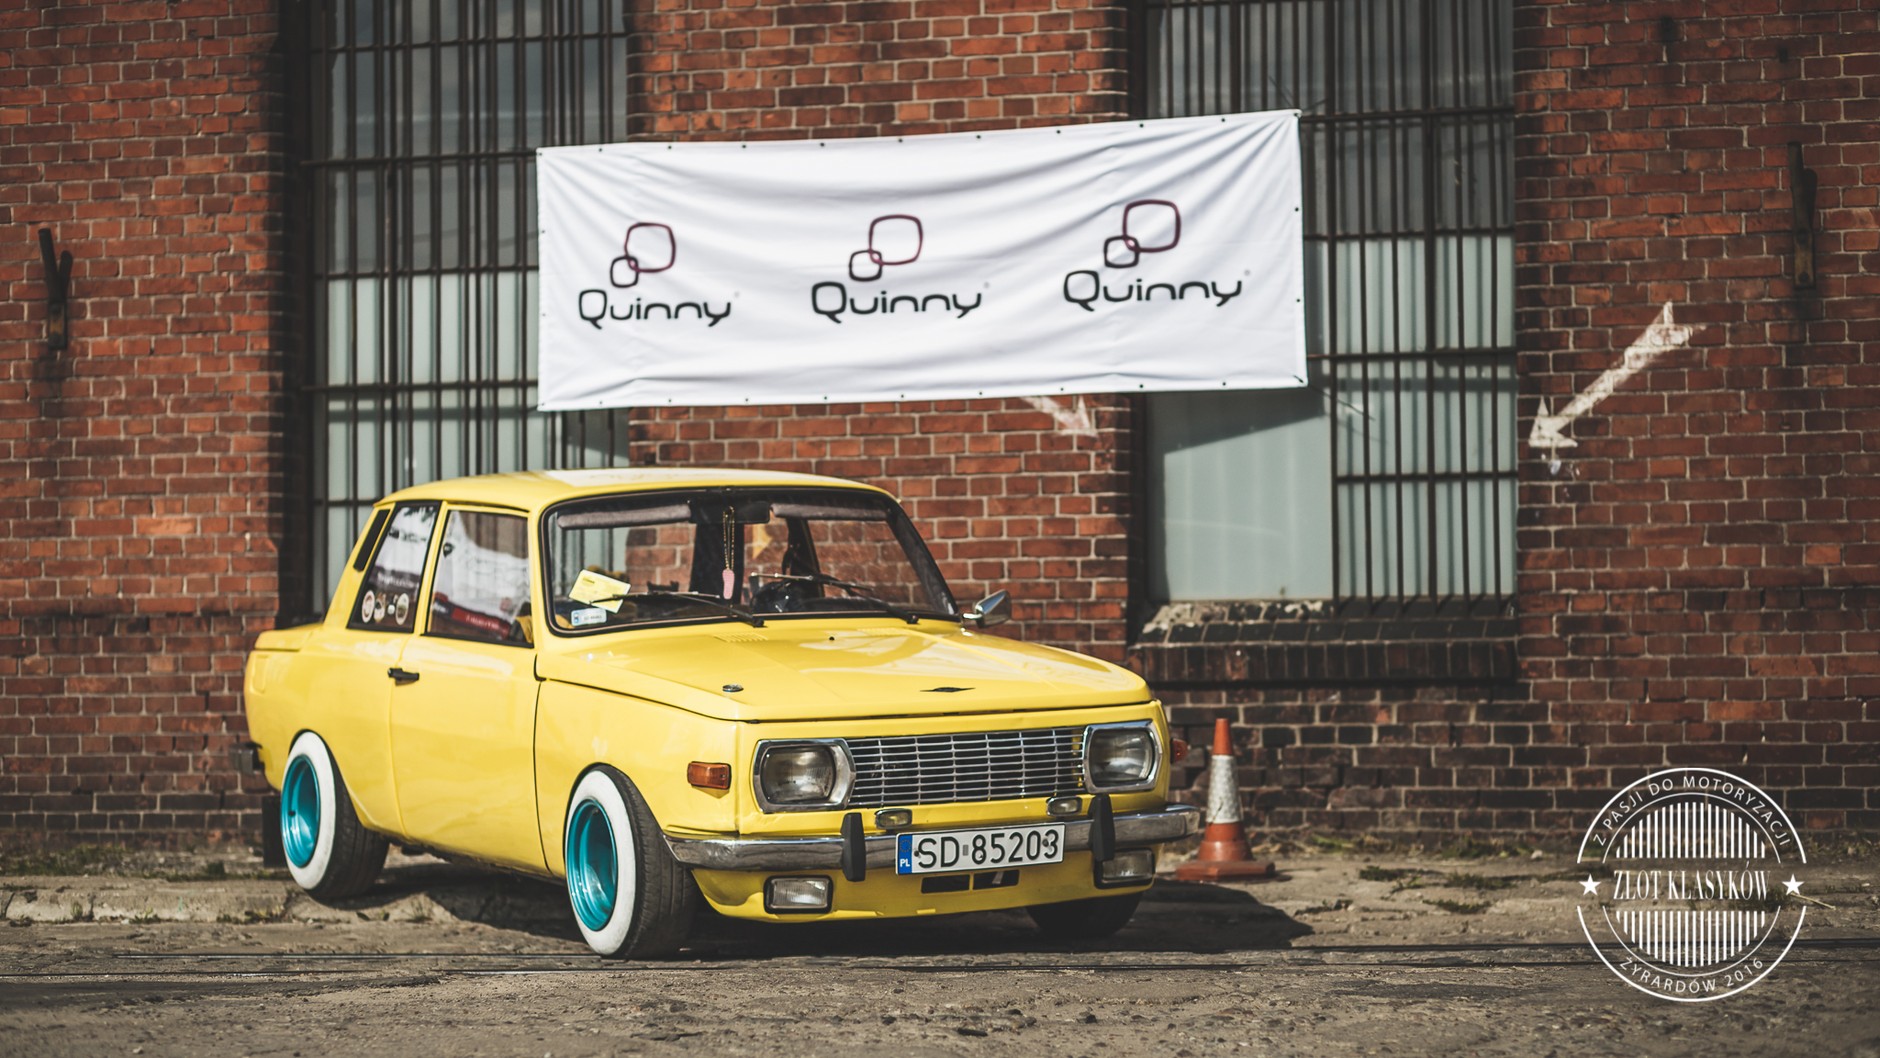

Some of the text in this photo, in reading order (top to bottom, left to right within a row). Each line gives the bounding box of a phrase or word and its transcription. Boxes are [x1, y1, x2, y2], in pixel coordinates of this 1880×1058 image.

[578, 289, 732, 329] Quinny
[811, 281, 983, 324] Quinny
[1063, 270, 1243, 312] Quinny
[900, 858, 911, 868] PL
[917, 829, 1059, 869] SD 85203
